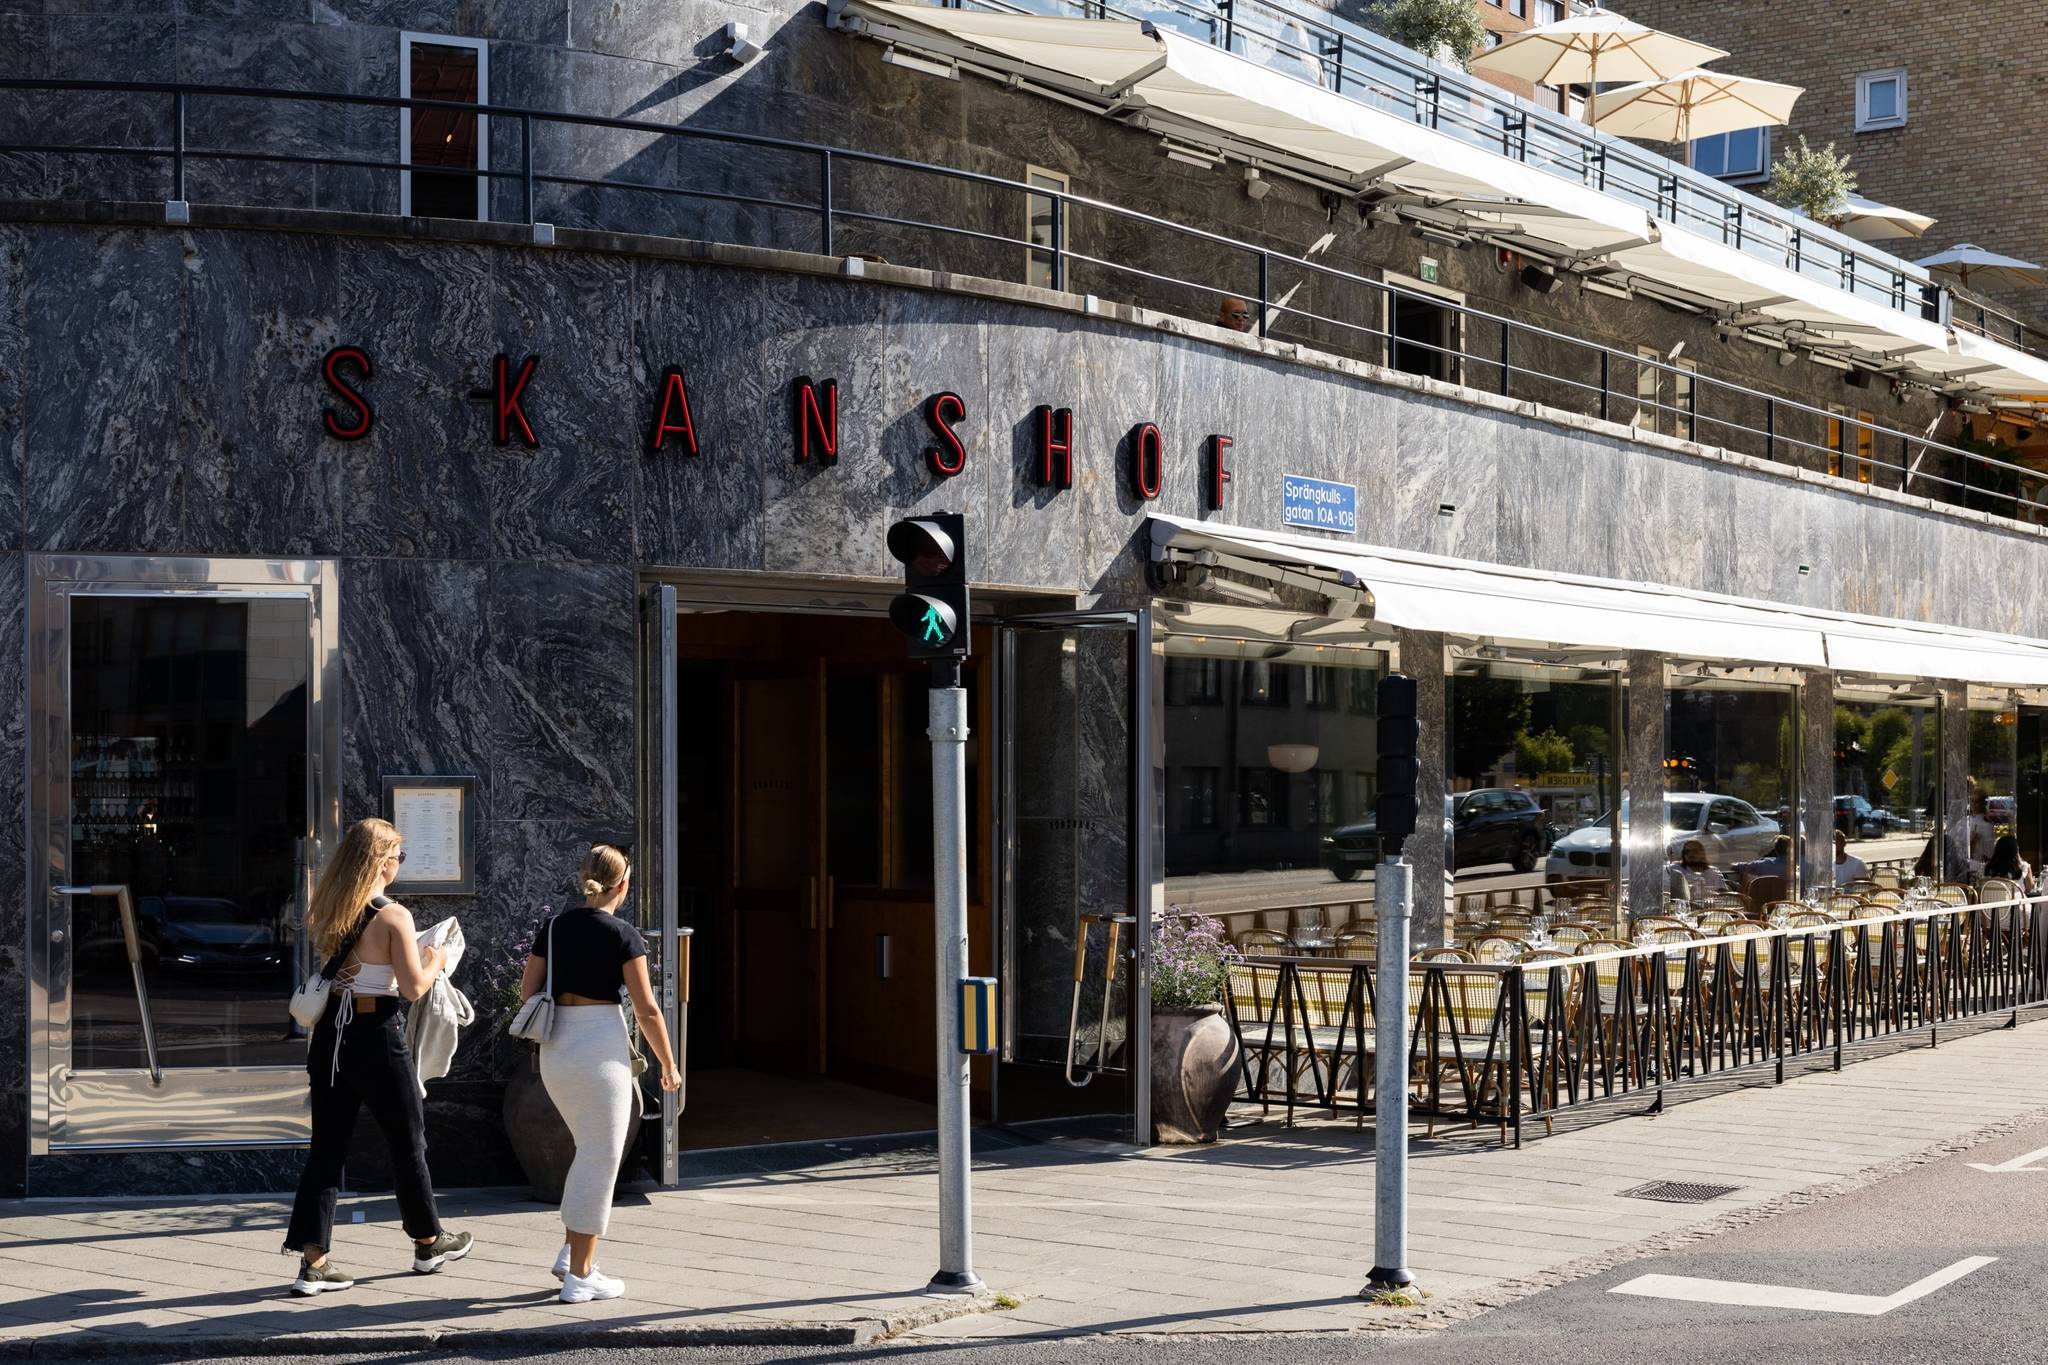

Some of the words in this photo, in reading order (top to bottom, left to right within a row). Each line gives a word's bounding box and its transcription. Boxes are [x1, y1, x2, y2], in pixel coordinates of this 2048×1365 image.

[322, 346, 1233, 511] SKANSHOF
[1285, 481, 1346, 504] Sprängkulls-
[1285, 505, 1314, 521] gatan
